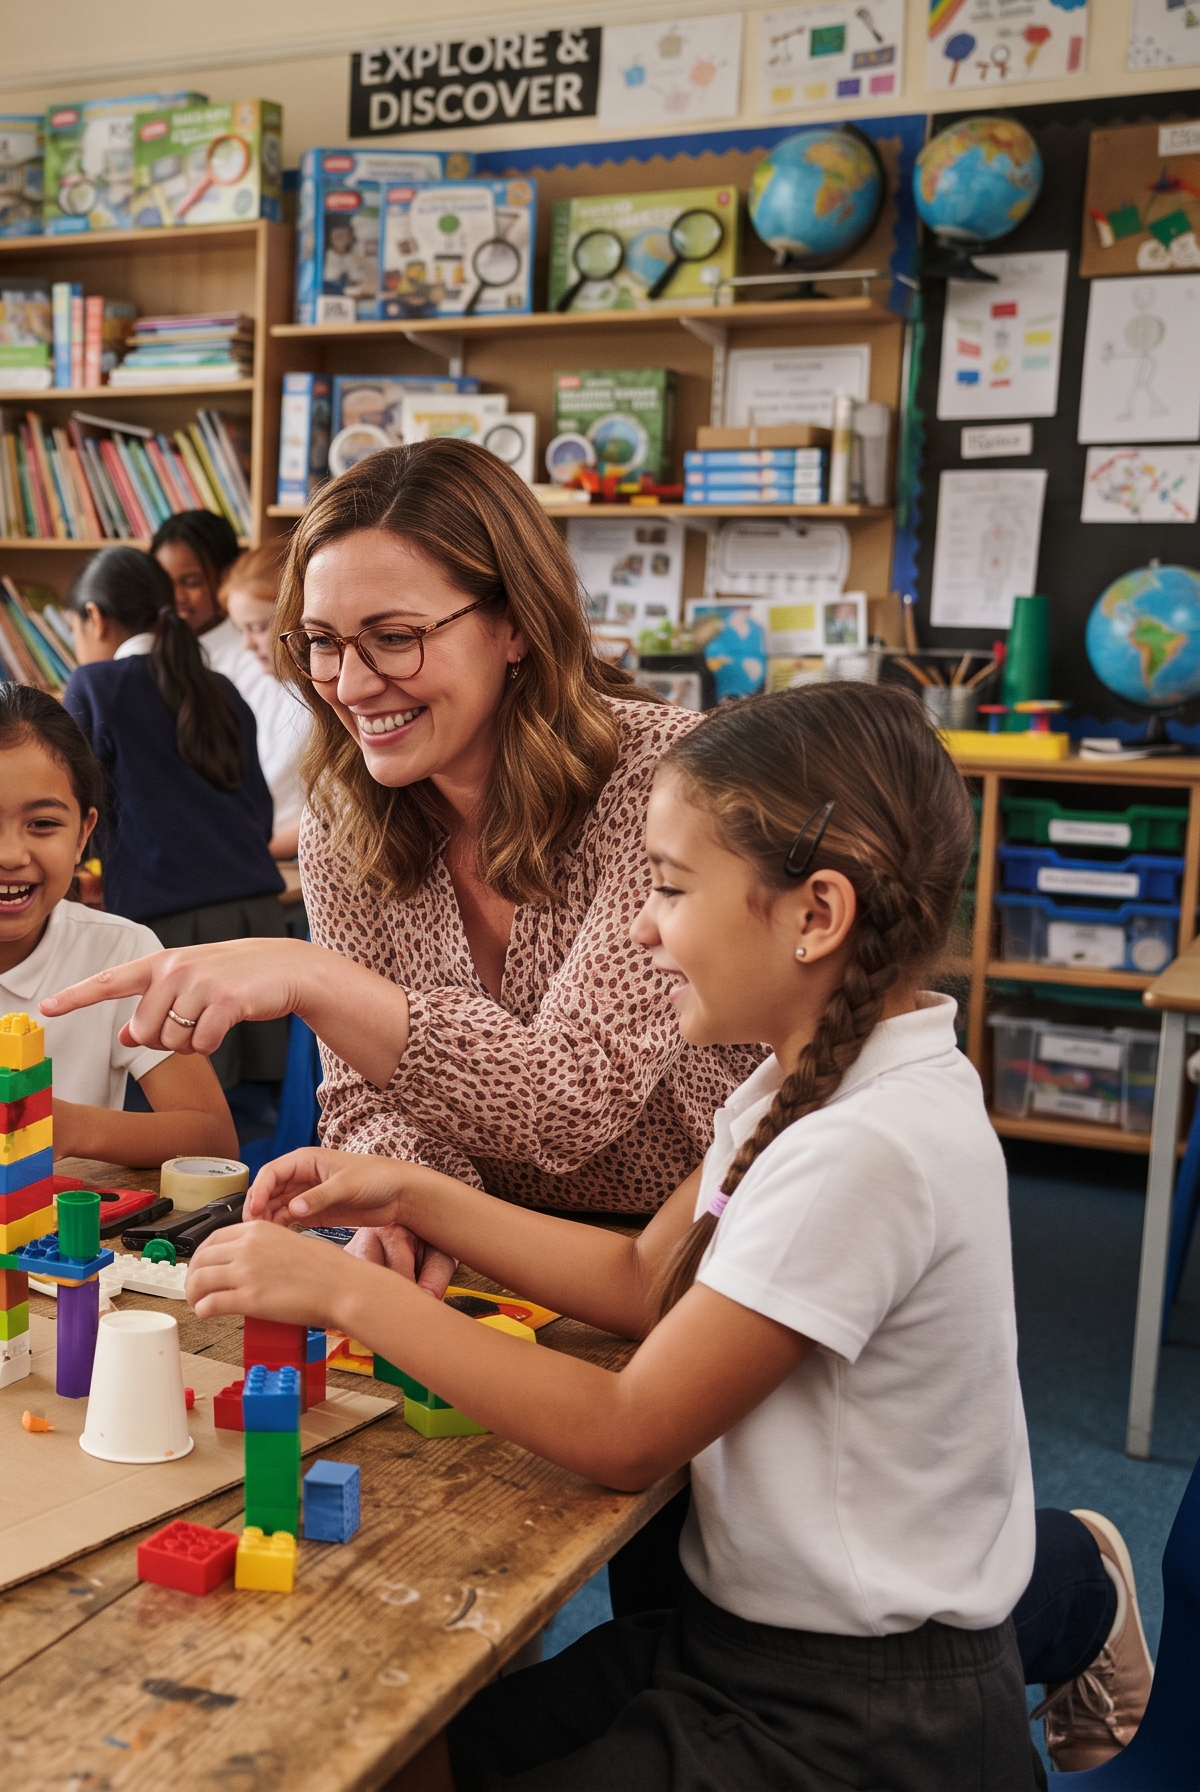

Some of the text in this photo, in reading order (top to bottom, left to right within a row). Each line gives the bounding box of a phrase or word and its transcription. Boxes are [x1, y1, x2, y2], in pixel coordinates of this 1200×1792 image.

[361, 29, 590, 86] EXPLORE &
[369, 73, 583, 130] DISCOVER
